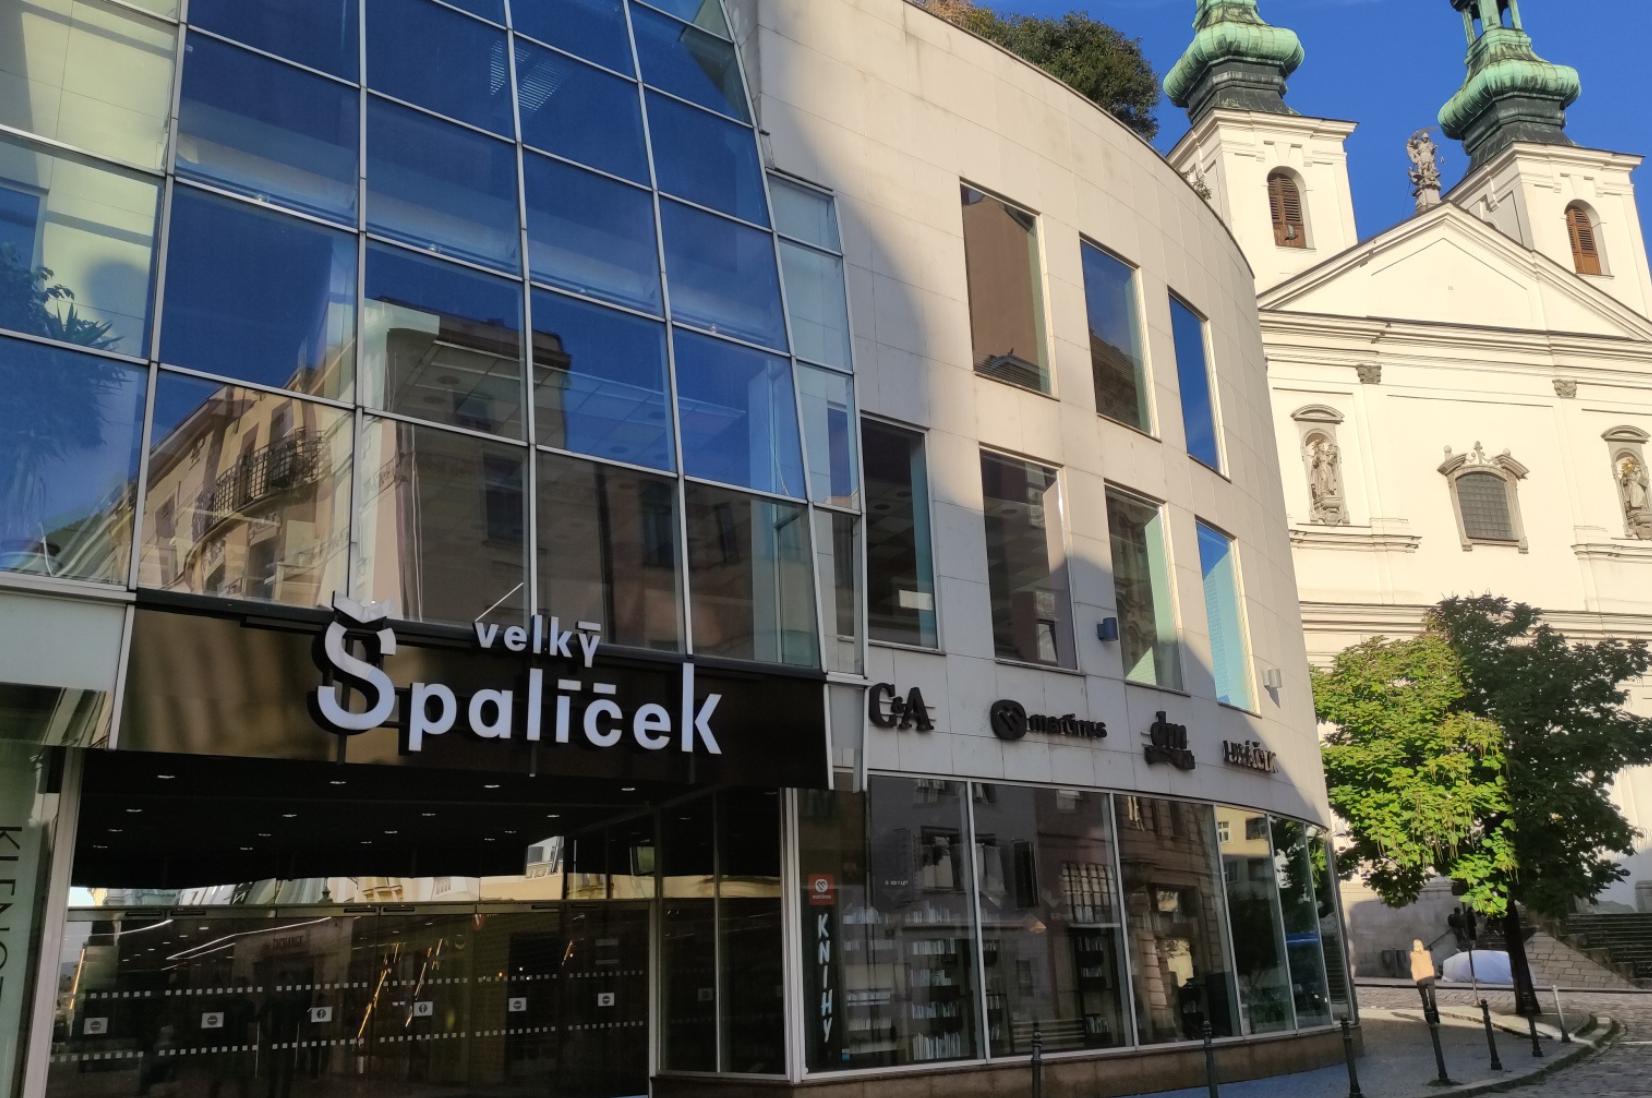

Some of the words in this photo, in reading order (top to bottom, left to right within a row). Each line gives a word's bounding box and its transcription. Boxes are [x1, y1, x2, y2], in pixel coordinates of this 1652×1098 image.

[474, 613, 602, 669] velký
[315, 591, 723, 755] Špalíček
[868, 682, 934, 732] C&A
[1151, 710, 1188, 750] dm
[817, 912, 833, 1043] KNIHY
